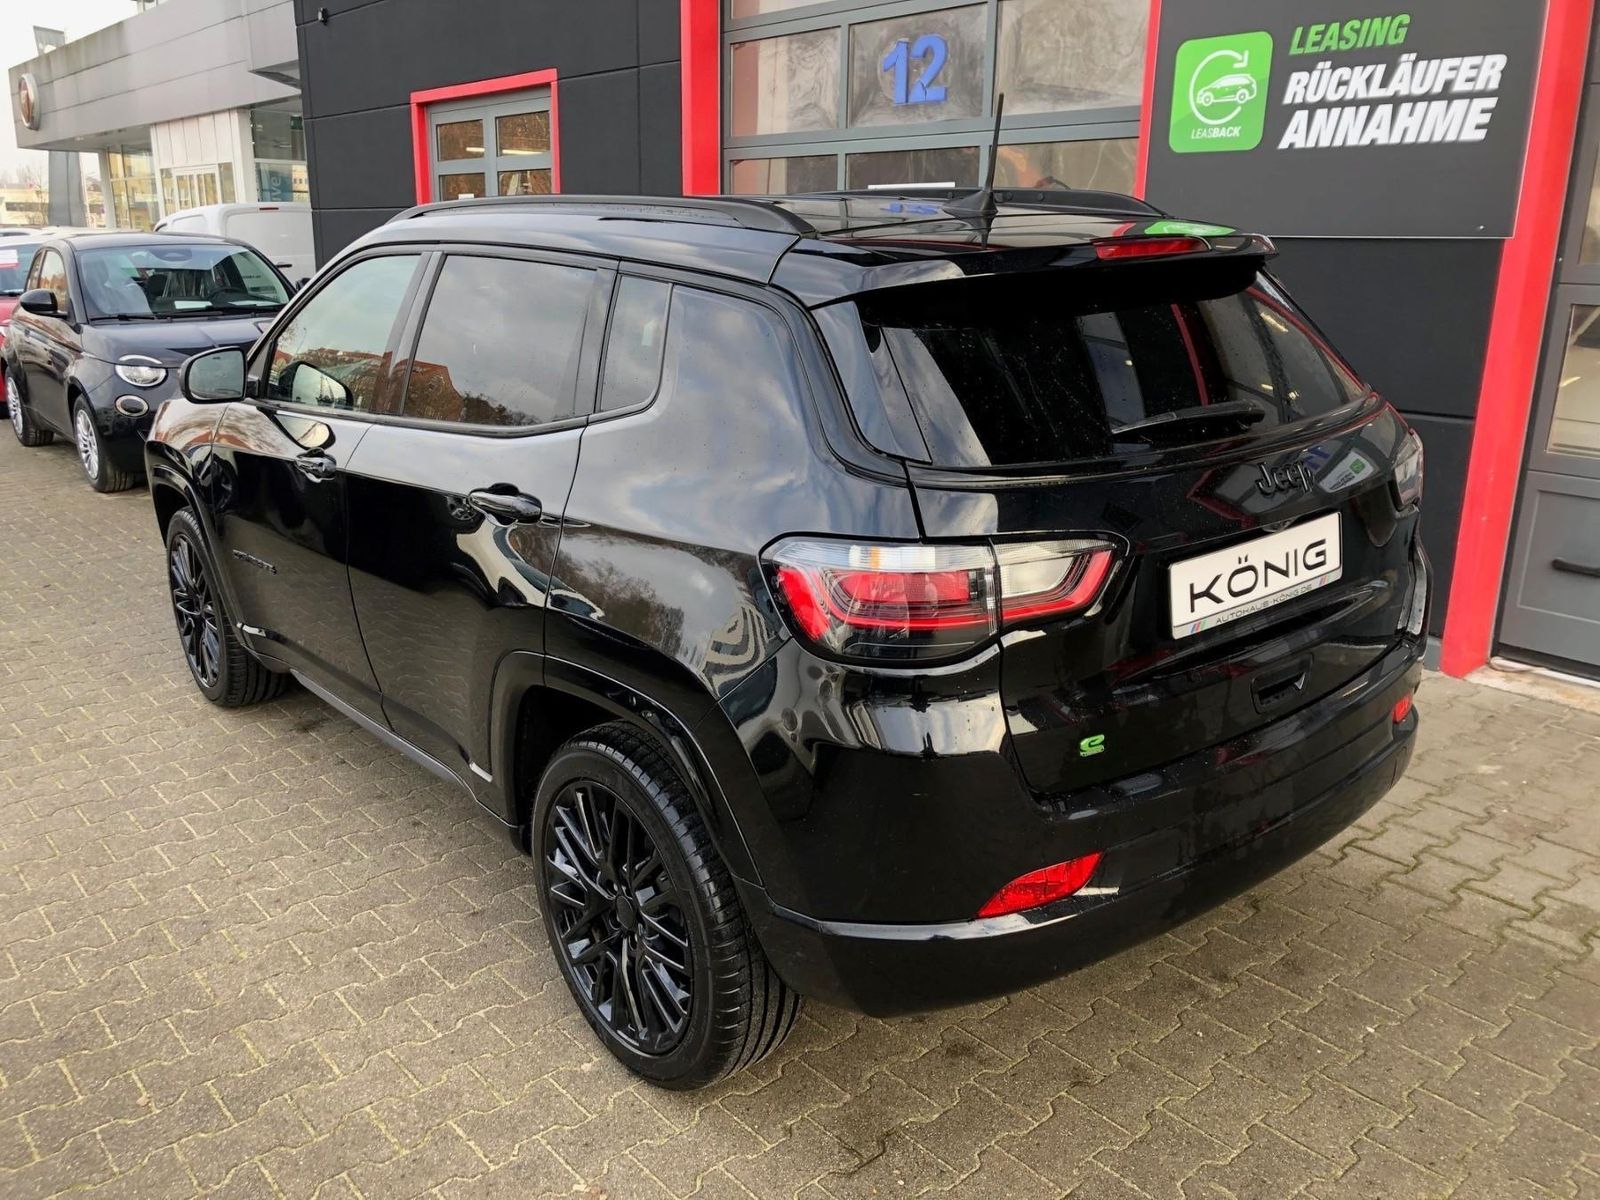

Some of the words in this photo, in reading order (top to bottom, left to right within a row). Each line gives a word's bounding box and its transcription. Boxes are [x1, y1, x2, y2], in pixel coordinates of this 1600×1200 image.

[1289, 14, 1410, 55] LEASING
[883, 33, 948, 105] 12
[1282, 53, 1507, 105] RÜCKLÄUFER
[1191, 126, 1242, 139] LEASBACK
[1277, 97, 1499, 149] ANNAHME
[1255, 461, 1314, 497] Jeep
[1189, 538, 1327, 613] KÖNIG
